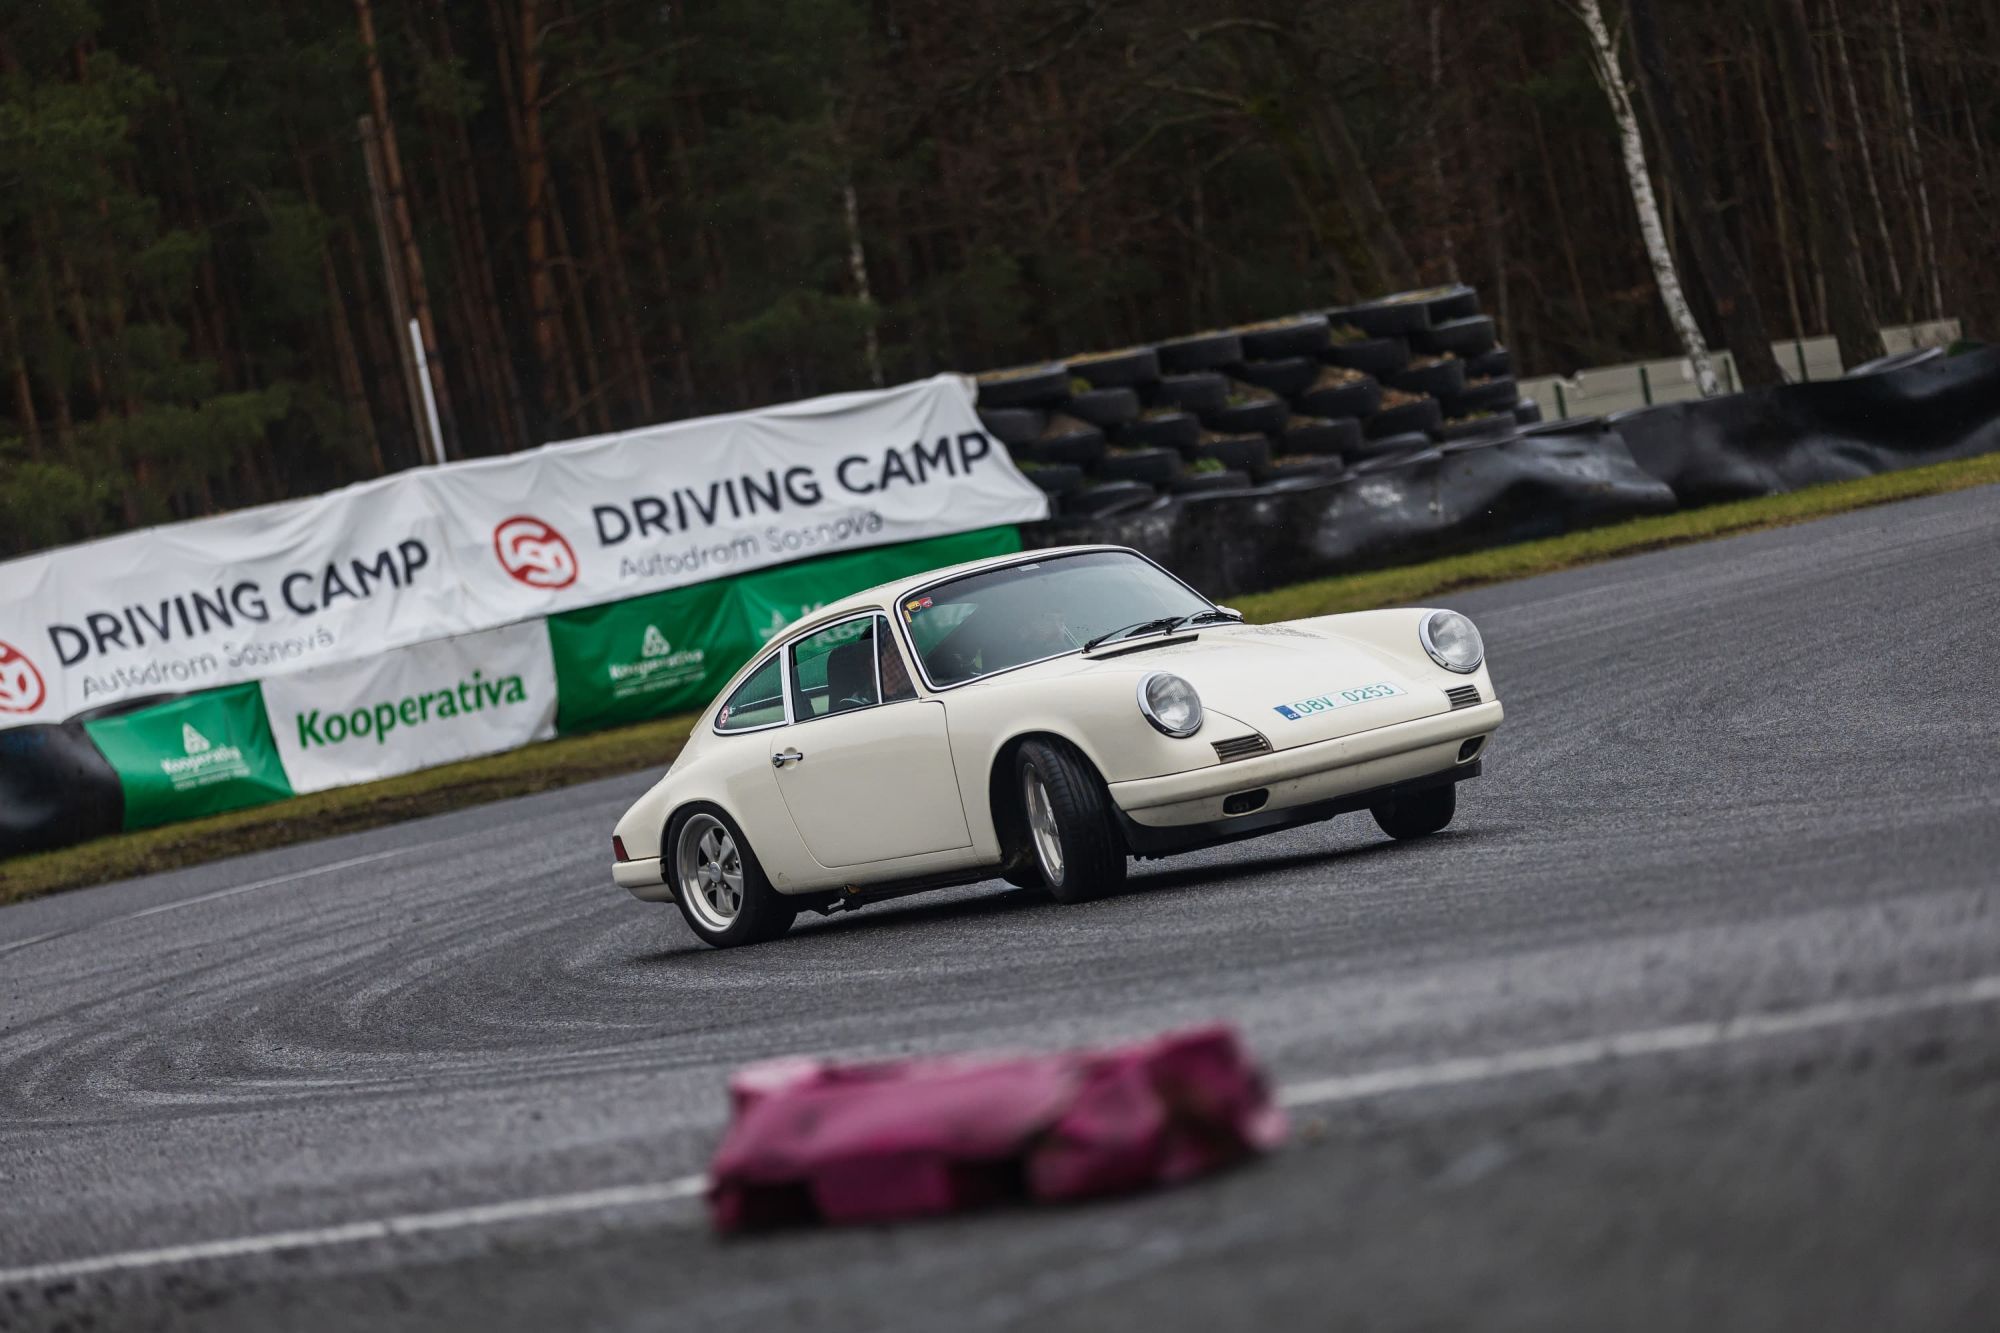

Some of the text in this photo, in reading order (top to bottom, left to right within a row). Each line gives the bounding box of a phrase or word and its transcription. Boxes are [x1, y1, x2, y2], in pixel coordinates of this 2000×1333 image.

[592, 431, 990, 547] DRIVING CAMP
[619, 534, 761, 579] Autodrom
[48, 539, 429, 667] DRIVING CAMP
[83, 653, 218, 699] Autodrom
[1294, 684, 1395, 714] 08V 0253
[297, 669, 526, 748] Kooperativa
